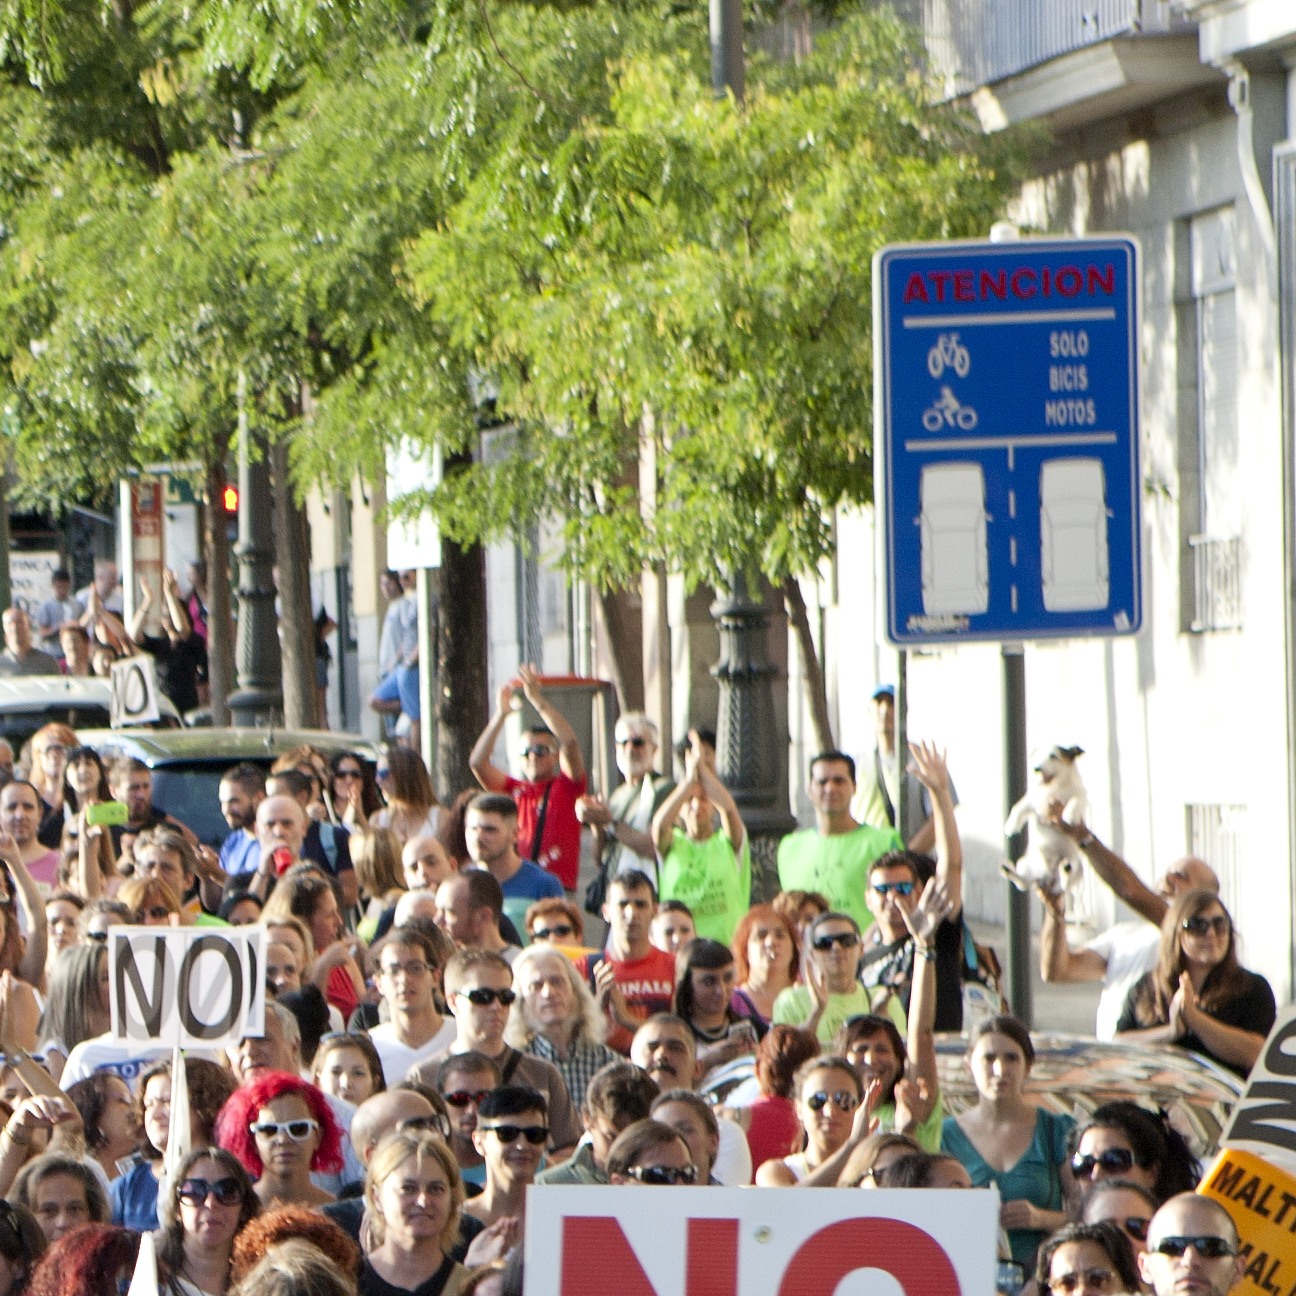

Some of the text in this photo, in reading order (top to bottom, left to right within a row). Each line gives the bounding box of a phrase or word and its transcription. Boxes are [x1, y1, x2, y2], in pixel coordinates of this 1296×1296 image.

[903, 263, 1115, 303] ATENCION
[1049, 331, 1089, 358] SOLO
[1049, 364, 1088, 391] BICIS
[1044, 399, 1096, 426] MOTOS
